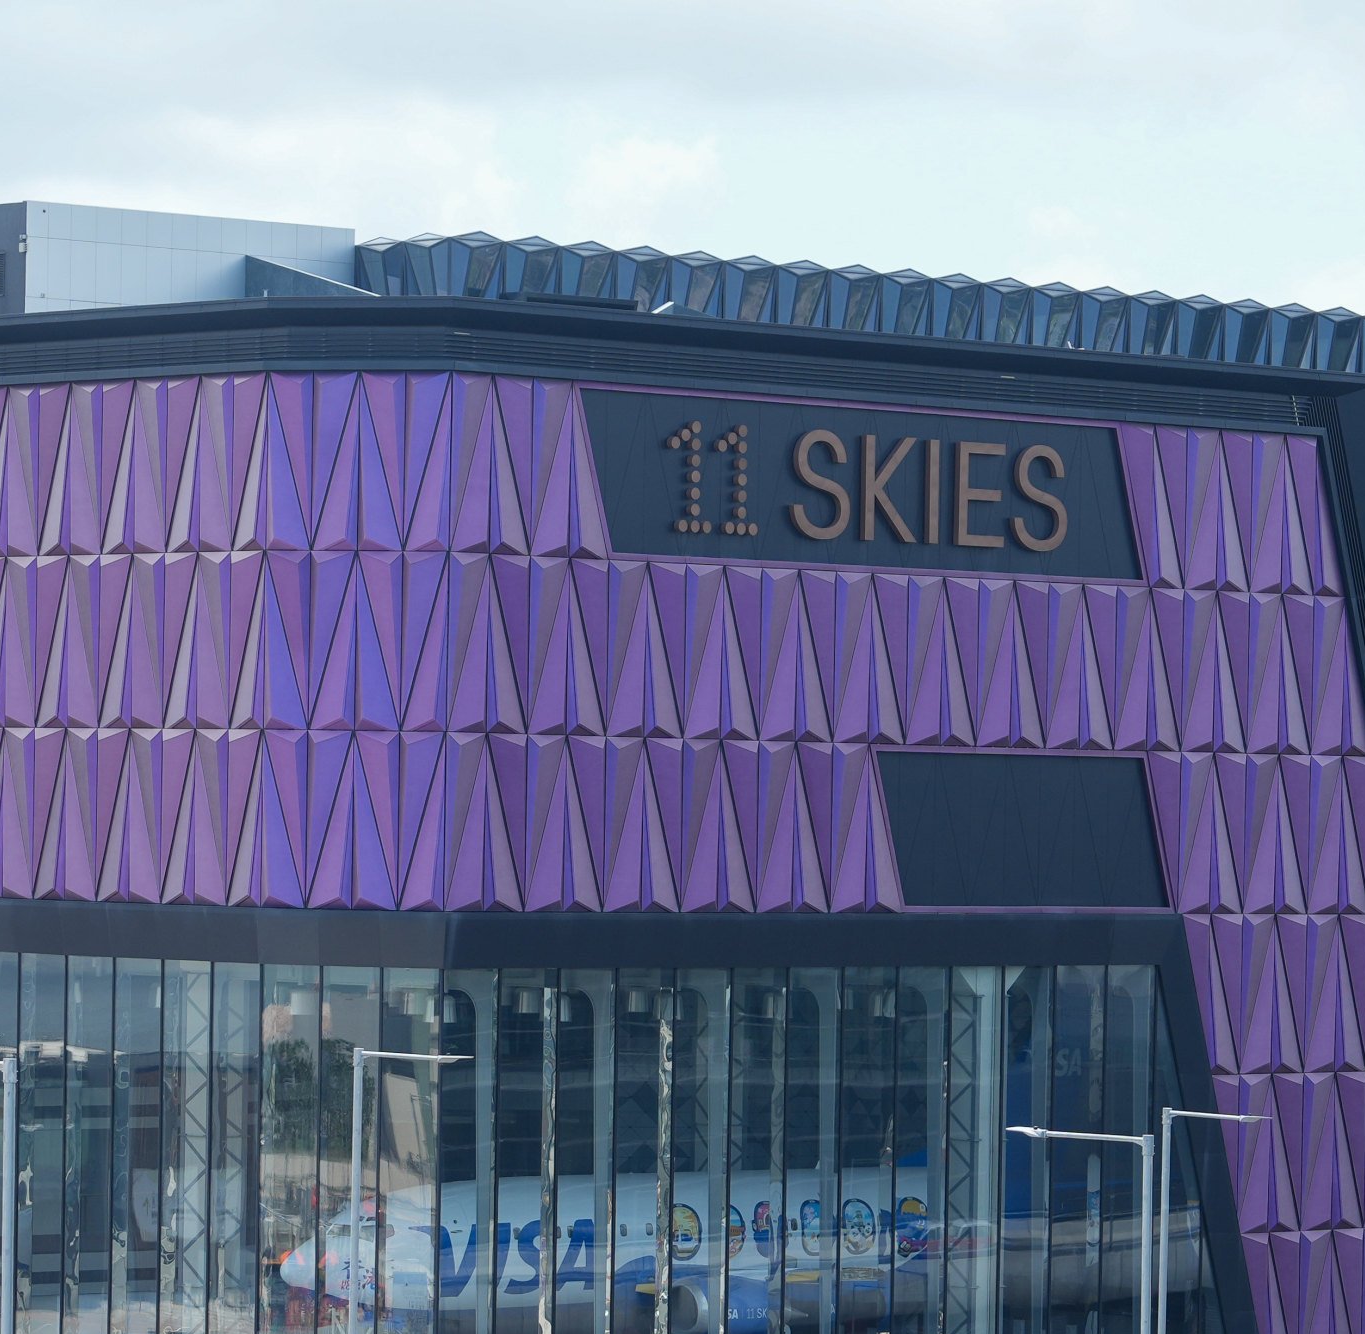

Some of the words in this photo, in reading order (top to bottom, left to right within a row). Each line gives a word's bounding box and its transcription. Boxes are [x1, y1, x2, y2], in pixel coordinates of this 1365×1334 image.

[667, 420, 758, 536] 11
[788, 428, 1068, 552] SKIES
[409, 1219, 595, 1297] VISA
